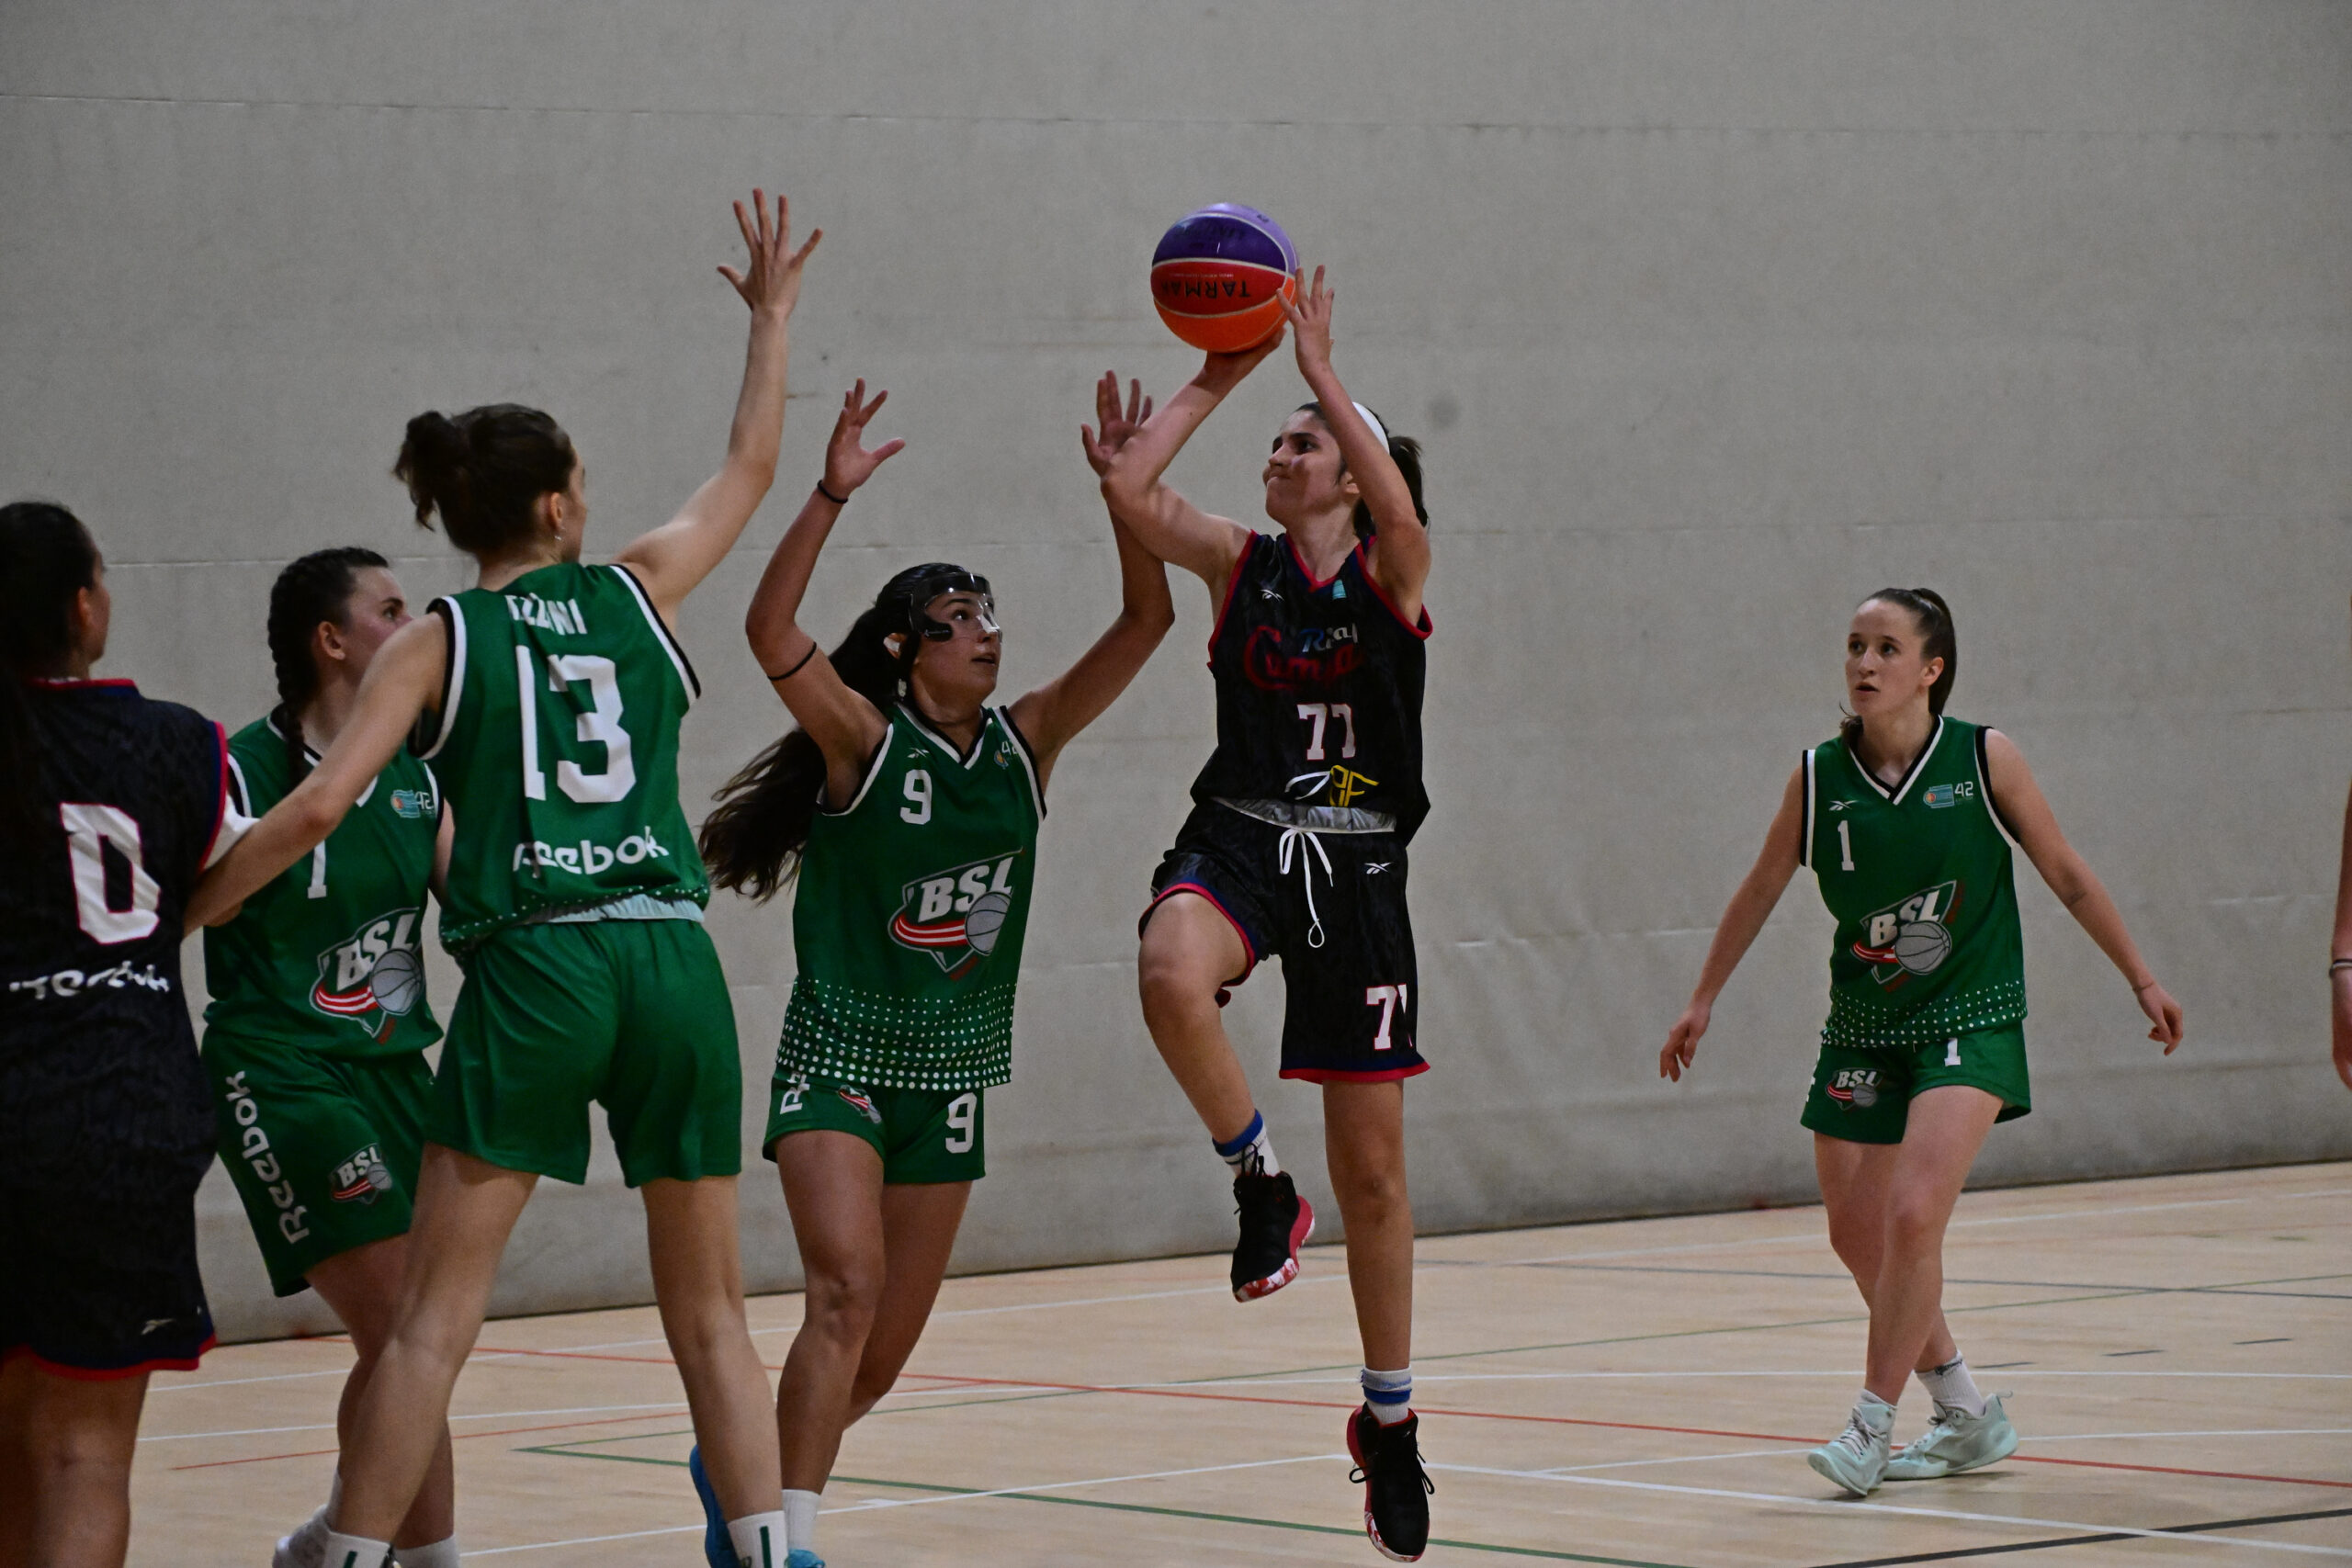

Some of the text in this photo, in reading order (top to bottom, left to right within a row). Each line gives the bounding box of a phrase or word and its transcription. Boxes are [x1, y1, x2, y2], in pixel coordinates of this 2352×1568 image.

[515, 645, 637, 804] 13
[1296, 702, 1356, 761] 77
[899, 768, 933, 826] 9
[1954, 781, 1974, 797] 42
[513, 825, 670, 879] Reebok
[1838, 819, 1856, 871] 1
[918, 856, 1014, 923] BSL
[1870, 889, 1941, 949] BSL
[335, 912, 417, 993] BSL
[1836, 1069, 1878, 1089] BSL
[945, 1091, 978, 1155] 9
[225, 1070, 310, 1245] Reebok
[336, 1145, 383, 1189] BSL
